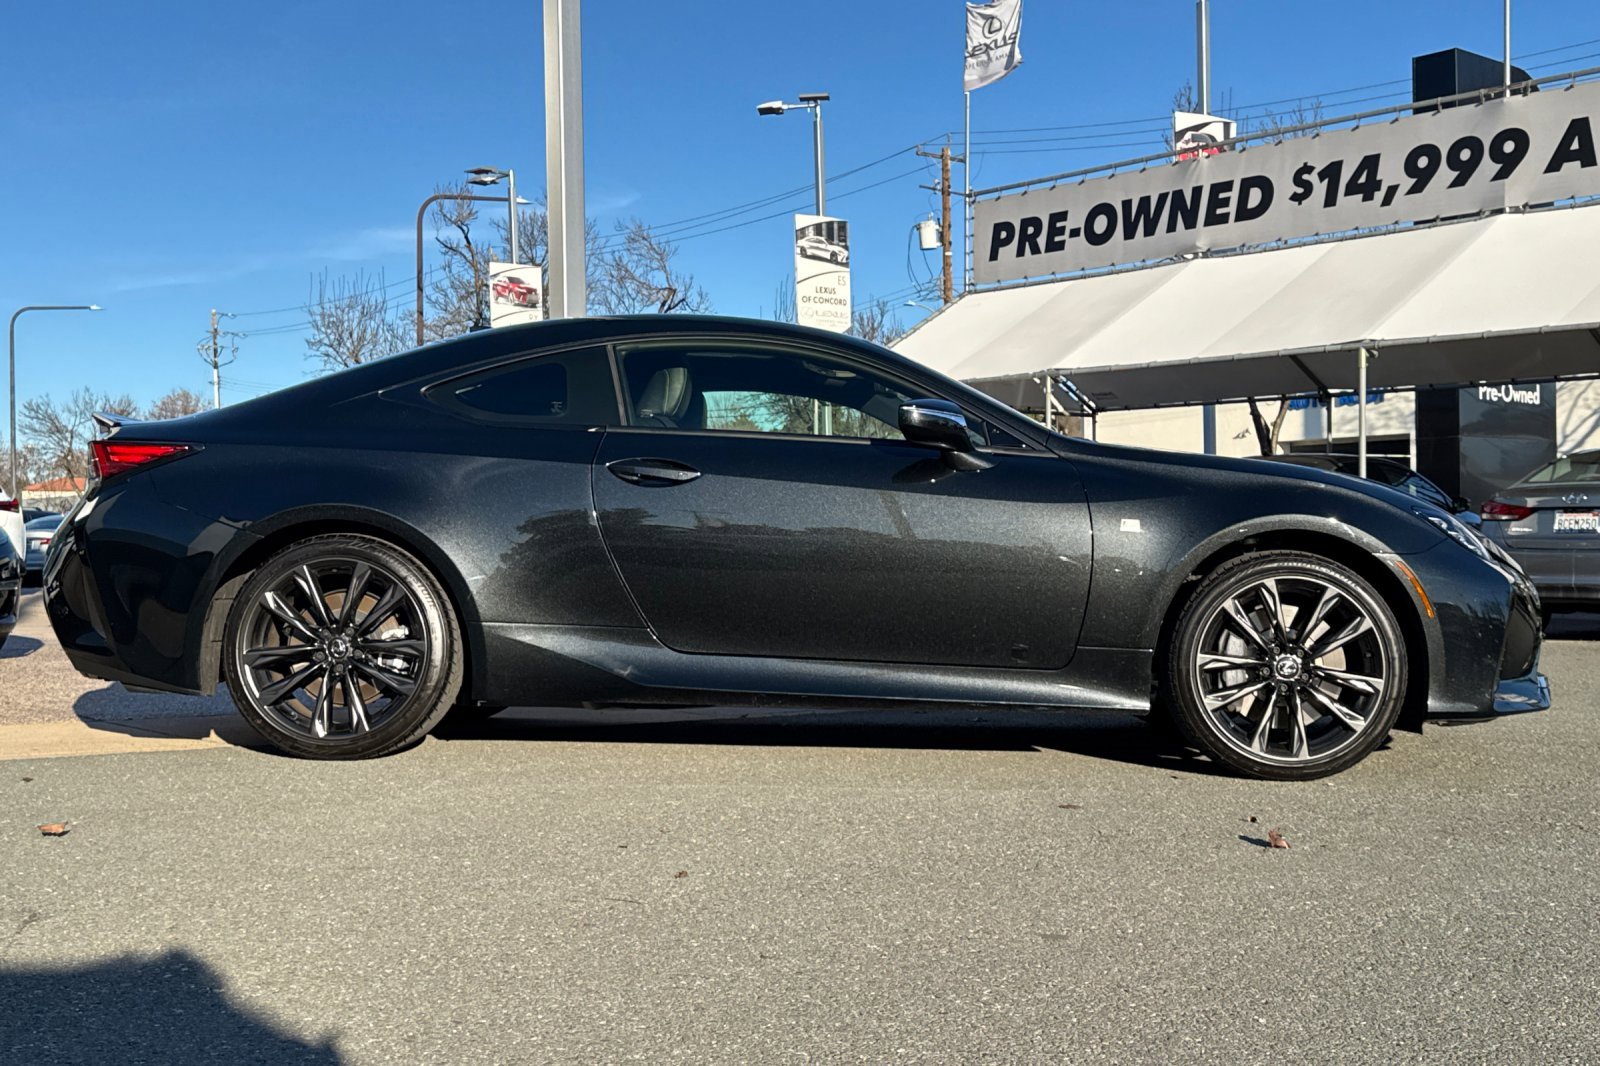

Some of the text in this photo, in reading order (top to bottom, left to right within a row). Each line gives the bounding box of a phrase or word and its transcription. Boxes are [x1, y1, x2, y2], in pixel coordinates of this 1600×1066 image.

[988, 116, 1598, 262] PRE-OWNED $14,999 A
[815, 286, 836, 295] LEXUS
[801, 295, 847, 306] OF CONCORD
[1479, 380, 1541, 405] Pre-Owned
